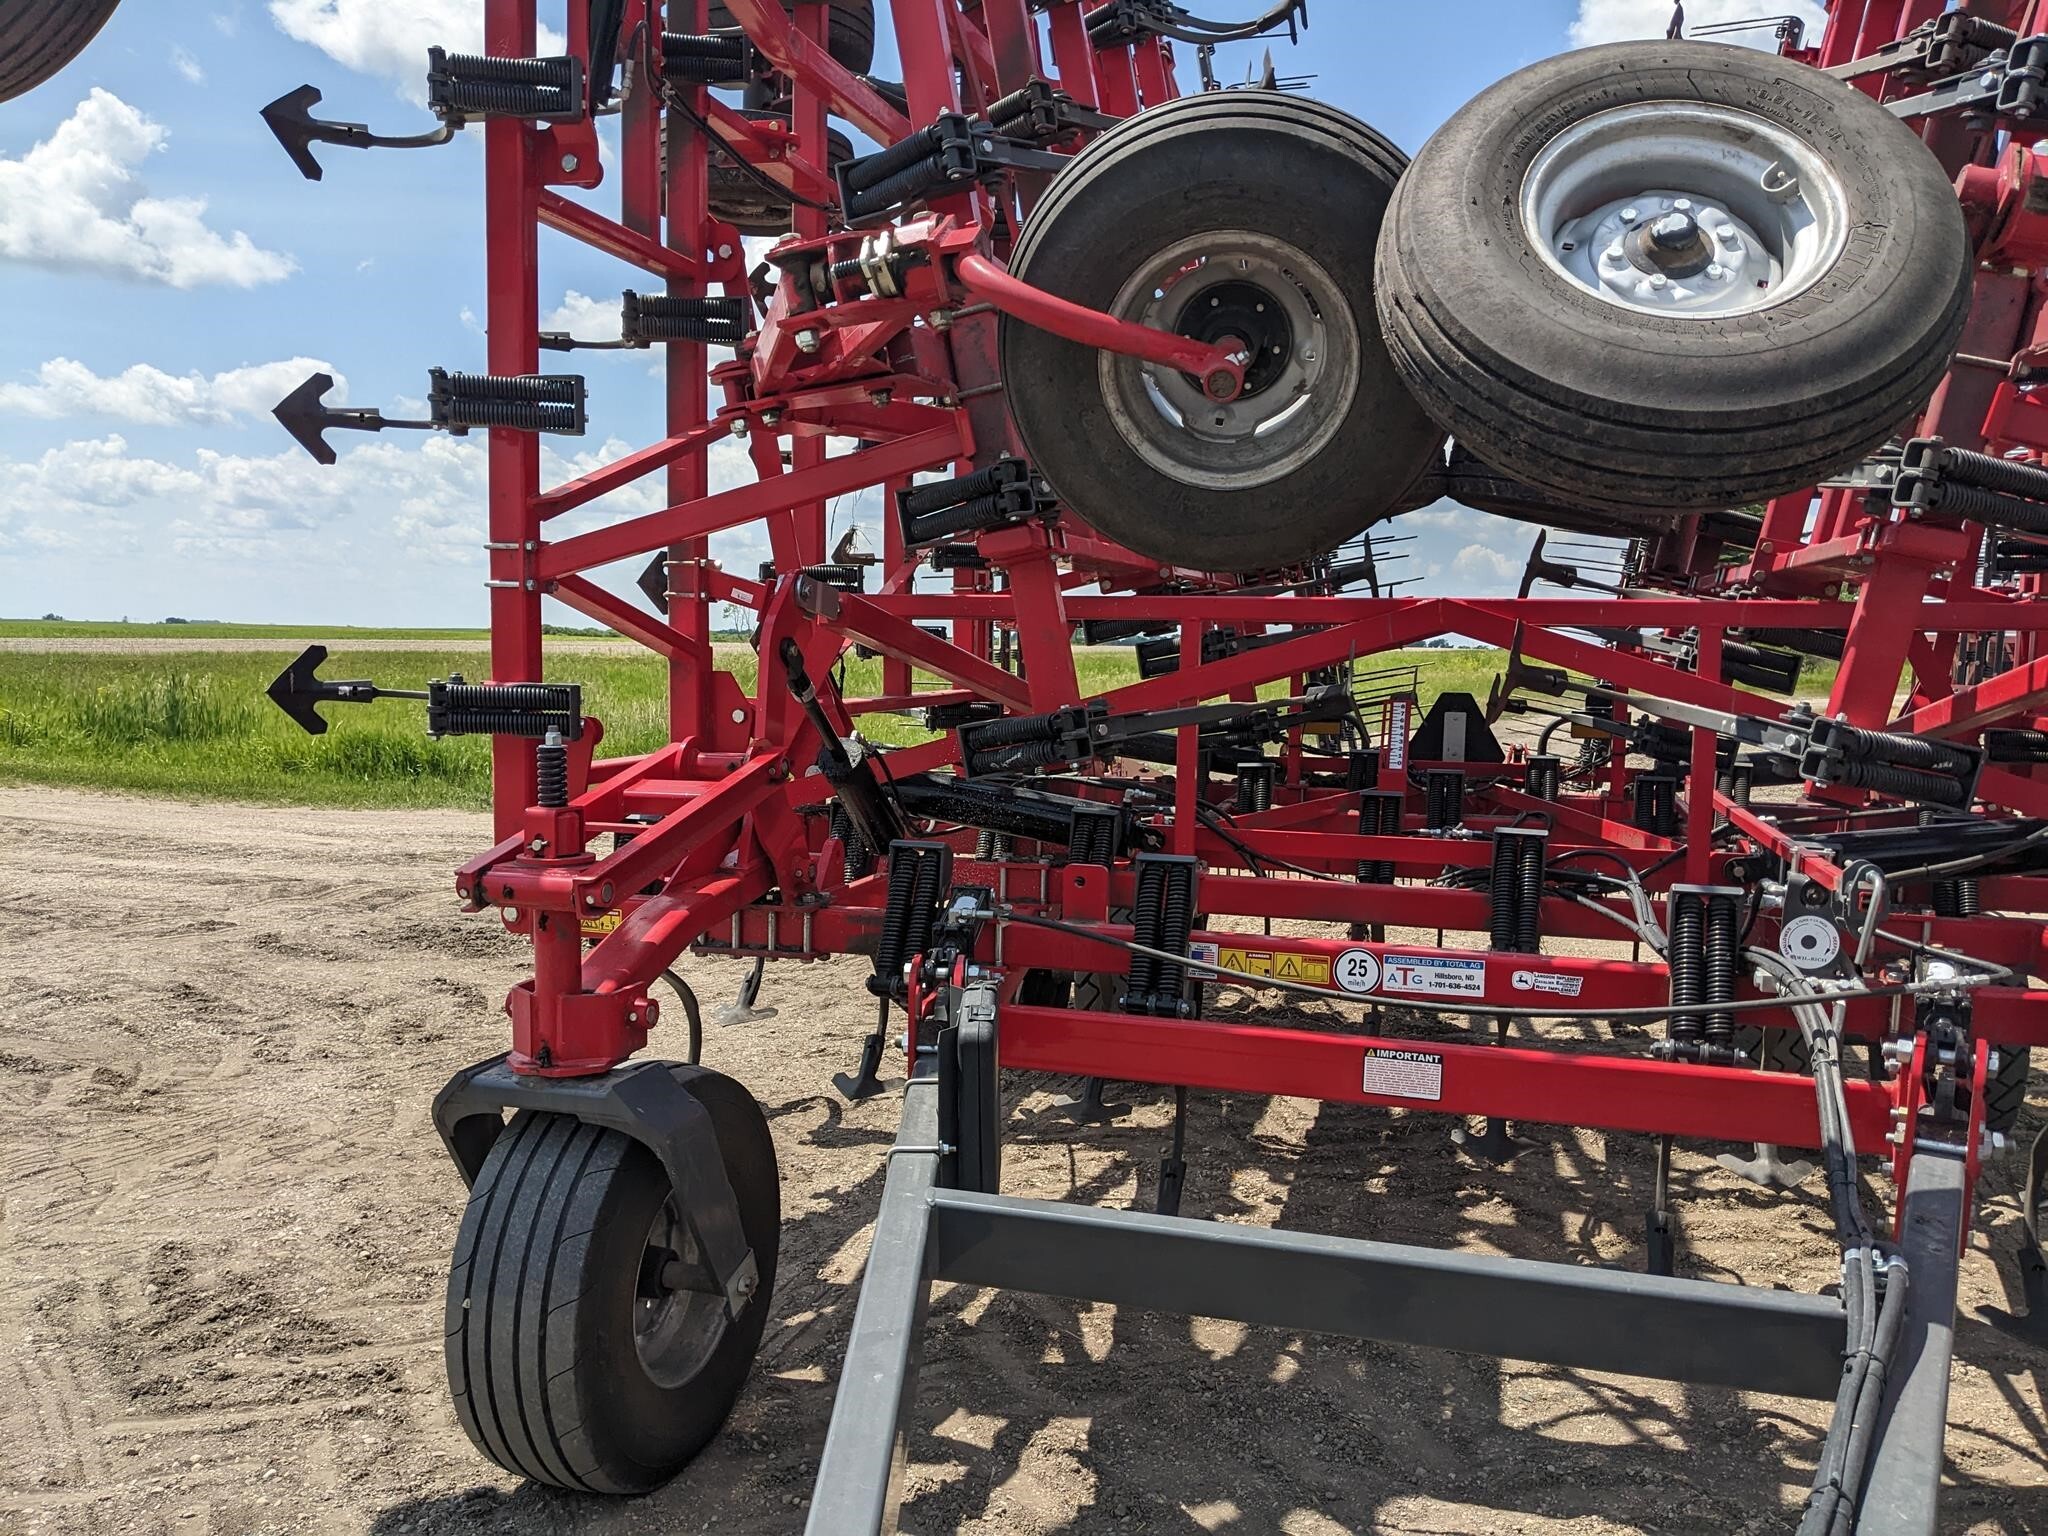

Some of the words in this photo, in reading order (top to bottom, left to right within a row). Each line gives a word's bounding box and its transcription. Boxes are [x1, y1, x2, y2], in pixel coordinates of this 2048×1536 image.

[1780, 229, 1887, 327] TITAN
[1347, 958, 1368, 978] 25
[1387, 957, 1433, 966] ASSEMBLED
[1445, 961, 1468, 969] TOTAL
[1387, 966, 1424, 986] ATG
[1434, 972, 1464, 981] Hillsboro,
[1347, 979, 1366, 988] mile/h
[1428, 981, 1481, 991] 1-701-636-4524
[1376, 1049, 1441, 1063] IMPORTANT
